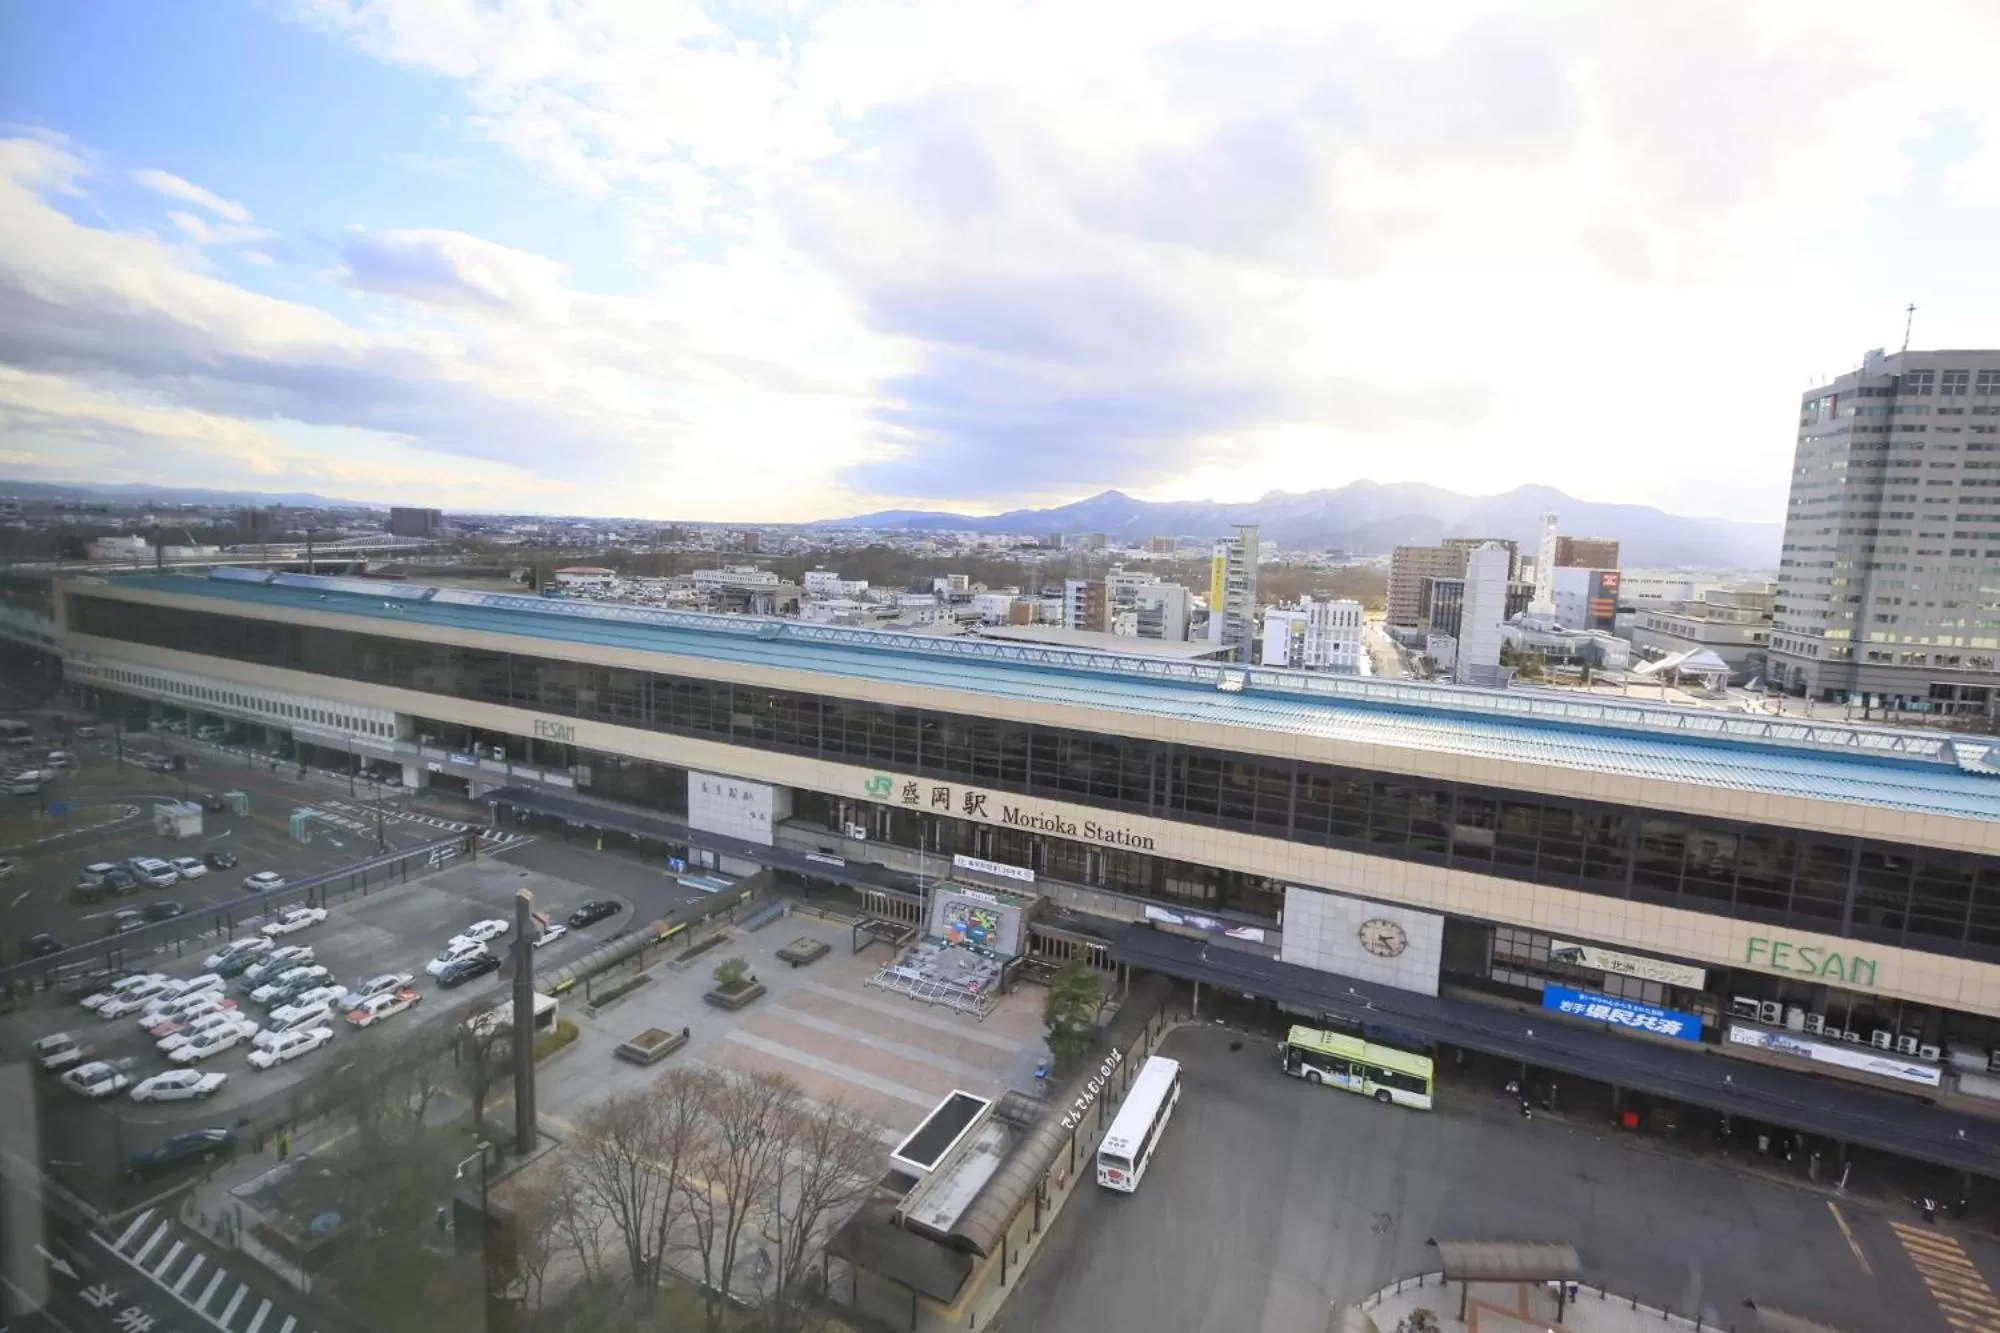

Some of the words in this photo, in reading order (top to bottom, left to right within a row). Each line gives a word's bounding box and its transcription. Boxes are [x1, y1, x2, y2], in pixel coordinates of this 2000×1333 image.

[534, 719, 576, 742] FESAN
[864, 776, 893, 793] JR
[902, 780, 989, 818] 盛岡駅
[1002, 805, 1077, 837] Morioka
[1083, 820, 1155, 850] Station
[1746, 937, 1876, 985] FESAN
[1061, 1047, 1122, 1129] でんでんむしのりば
